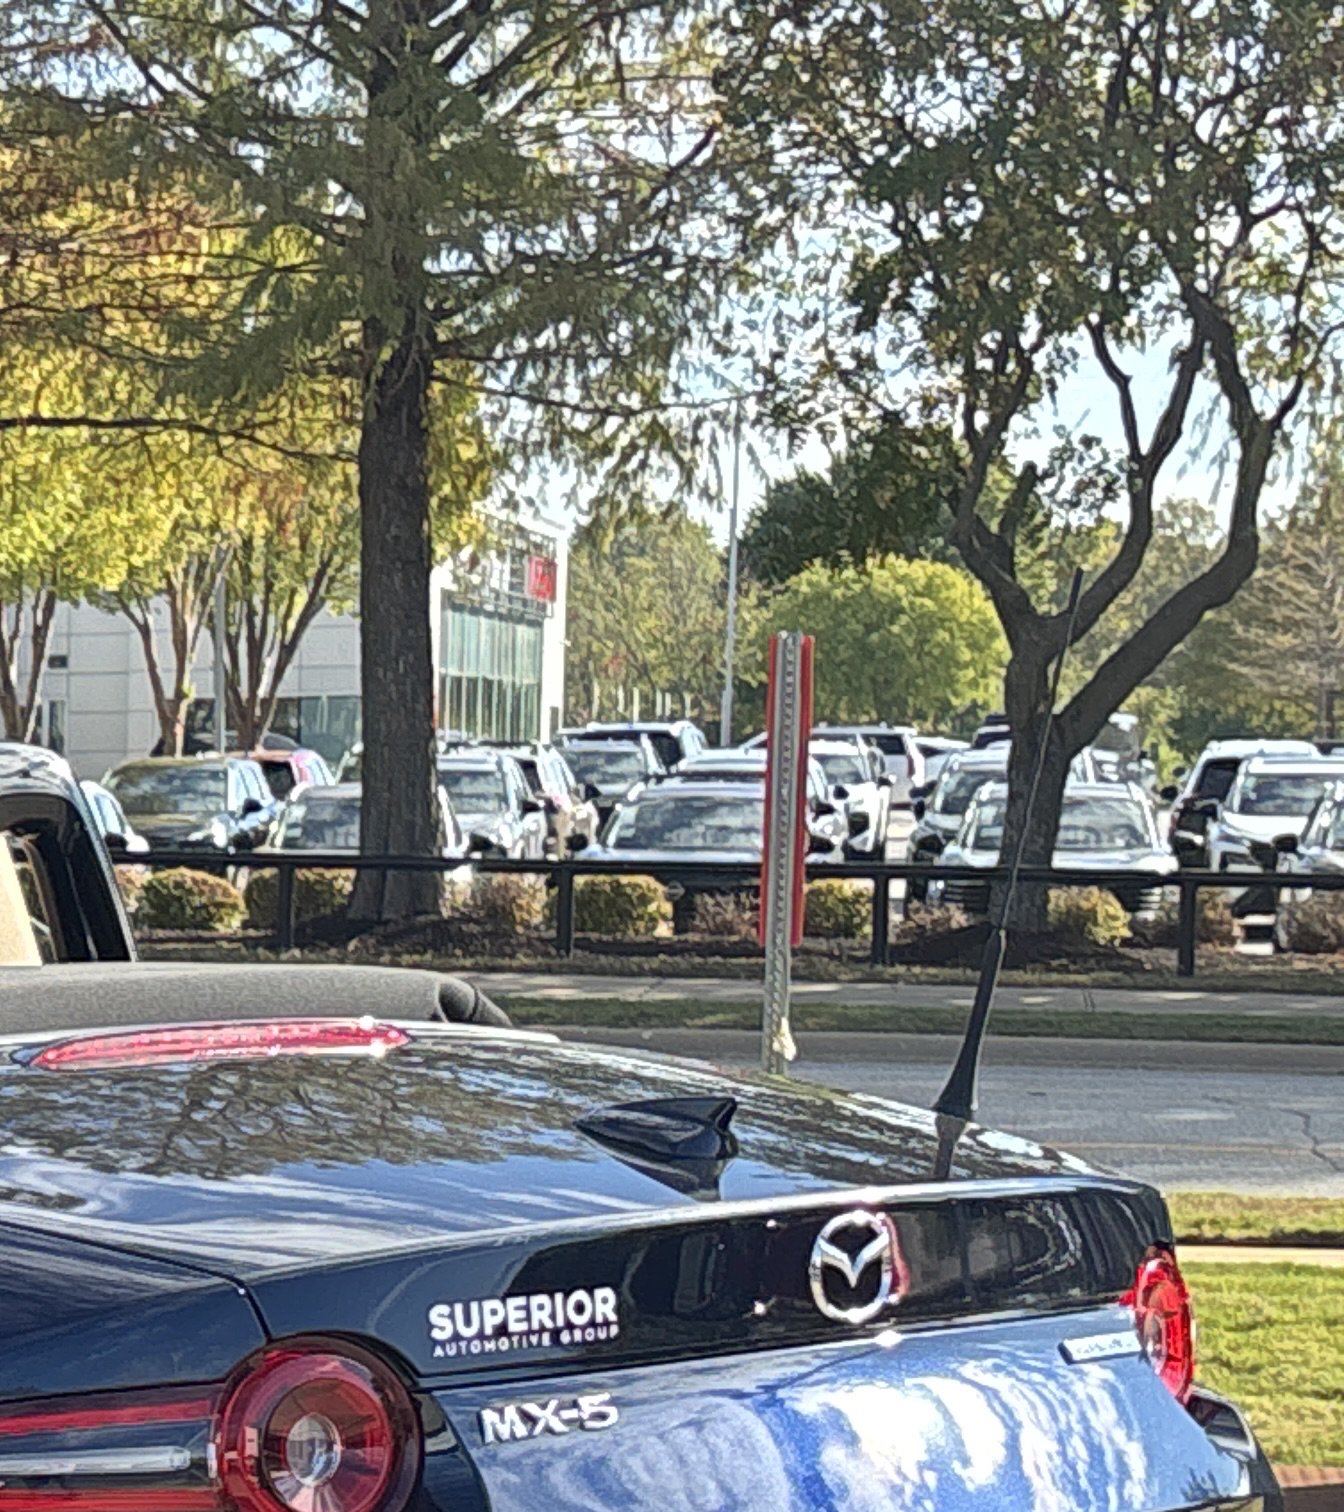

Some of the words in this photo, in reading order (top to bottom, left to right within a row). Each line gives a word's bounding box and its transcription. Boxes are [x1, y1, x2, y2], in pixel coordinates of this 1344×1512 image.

[429, 1287, 618, 1340] SUPERIOR
[433, 1332, 552, 1358] AUTOMOTIVE
[560, 1324, 620, 1345] GROUP
[479, 1392, 619, 1444] MX-5
